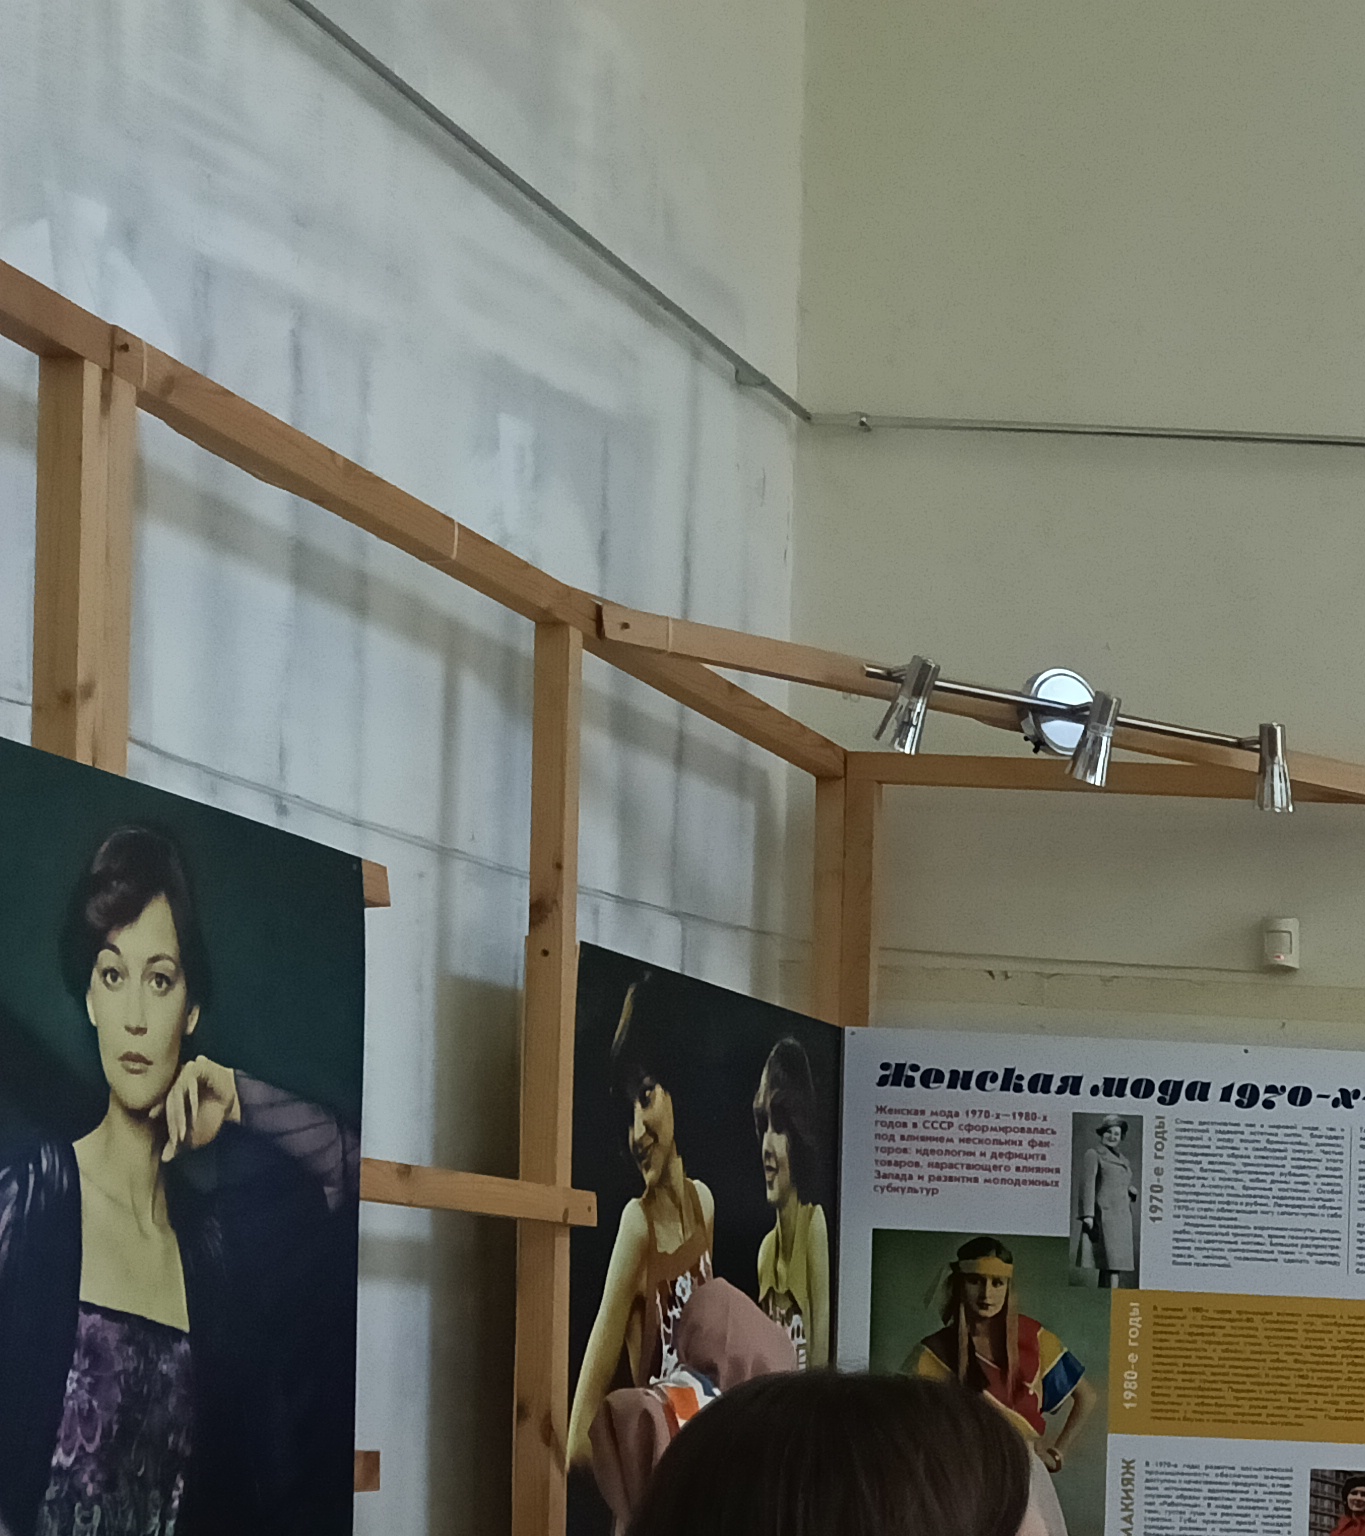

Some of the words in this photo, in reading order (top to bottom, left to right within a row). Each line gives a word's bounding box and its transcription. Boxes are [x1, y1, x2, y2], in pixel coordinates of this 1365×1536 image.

[876, 1061, 1084, 1097] Женская
[1089, 1074, 1212, 1106] мода
[875, 1105, 926, 1117] Женская
[930, 1109, 959, 1119] мода
[875, 1120, 907, 1130] годов
[923, 1120, 954, 1131] СССР
[958, 1123, 1057, 1135] сформировалась
[875, 1133, 895, 1143] под
[900, 1134, 954, 1144] влиянием
[959, 1136, 1023, 1147] нескольких
[1028, 1138, 1055, 1149] фак-
[1154, 1115, 1168, 1160] годы
[916, 1147, 976, 1157] идеологии
[980, 1150, 986, 1158] и
[990, 1150, 1046, 1161] дефицита
[927, 1160, 1011, 1172] нарастающего
[1015, 1165, 1061, 1174] влияния
[874, 1170, 913, 1181] Запада
[918, 1174, 924, 1182] и
[928, 1173, 979, 1184] развития
[873, 1182, 939, 1197] субкультур
[1149, 1166, 1164, 1223] 1970-е
[1128, 1301, 1140, 1347] годы
[1123, 1353, 1139, 1410] 1980-е
